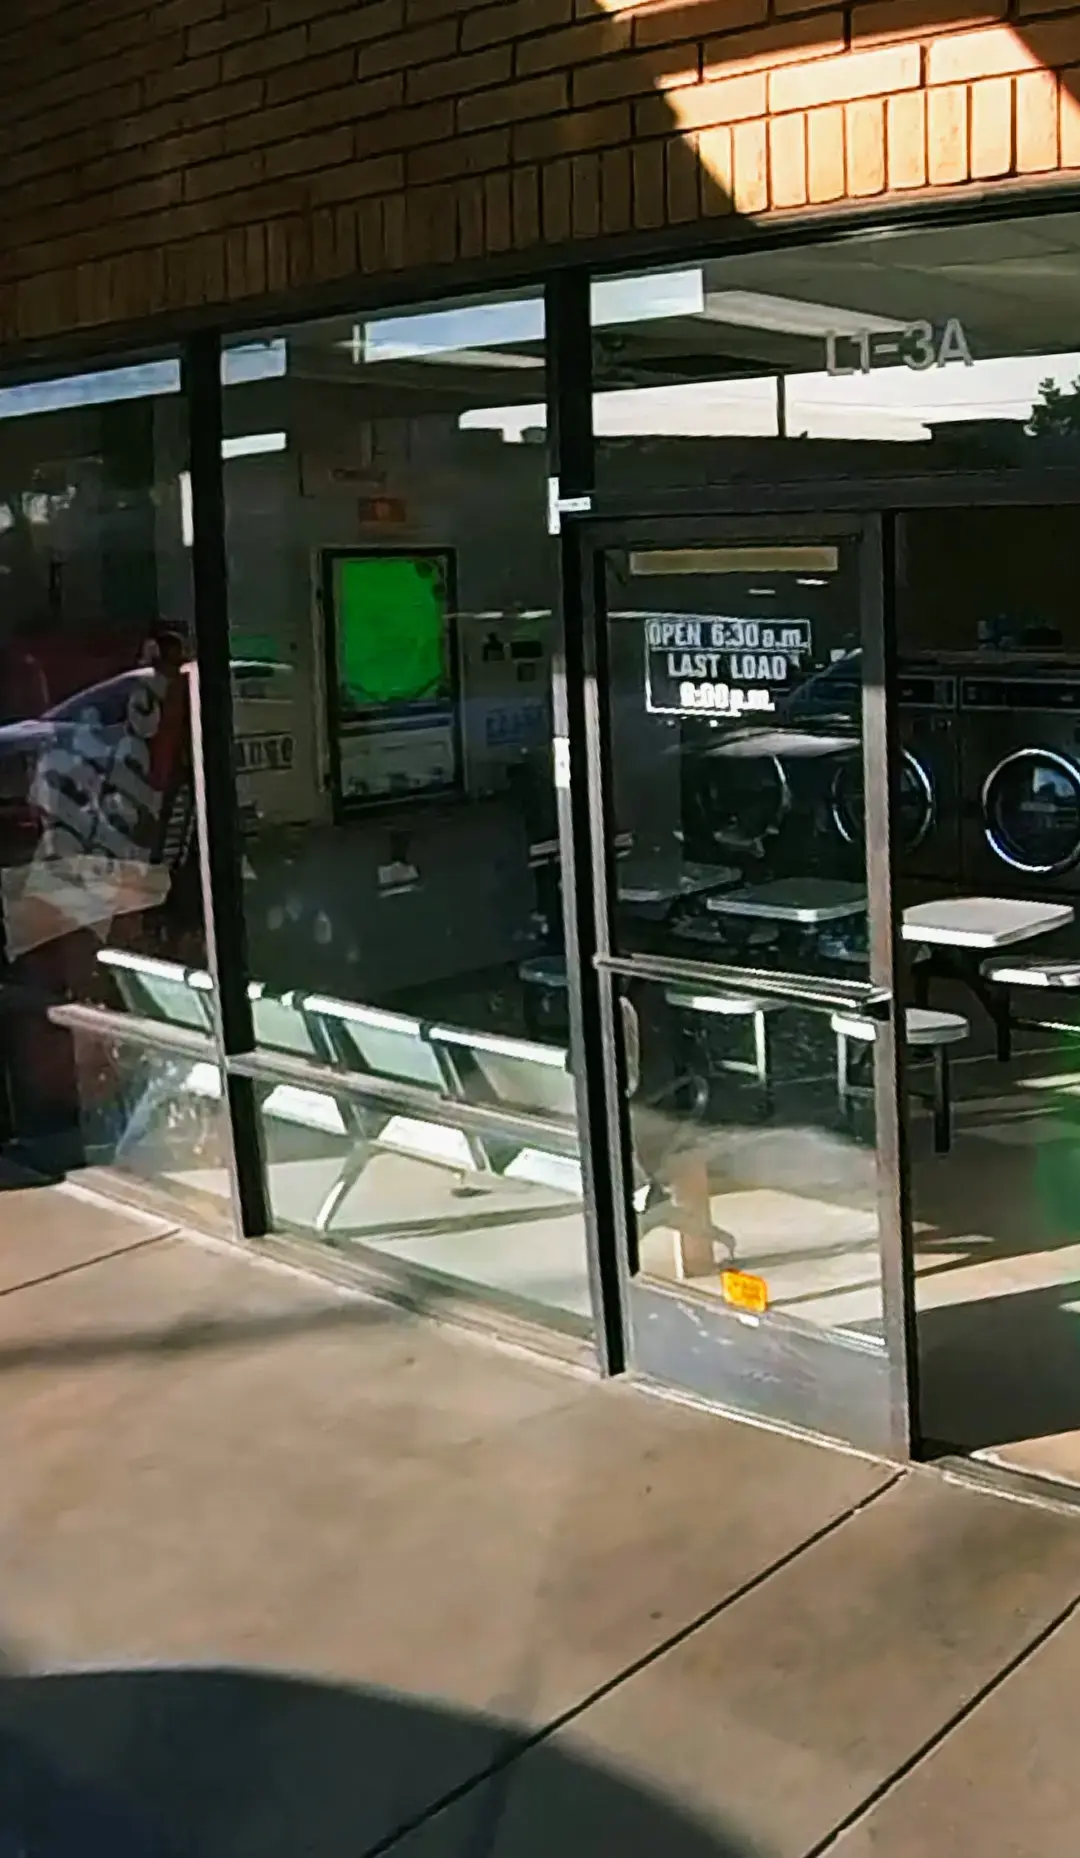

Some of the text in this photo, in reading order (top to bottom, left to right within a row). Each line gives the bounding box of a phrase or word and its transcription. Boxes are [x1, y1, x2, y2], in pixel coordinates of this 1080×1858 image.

[649, 622, 701, 646] OPEN
[667, 653, 787, 680] LAST LOAD
